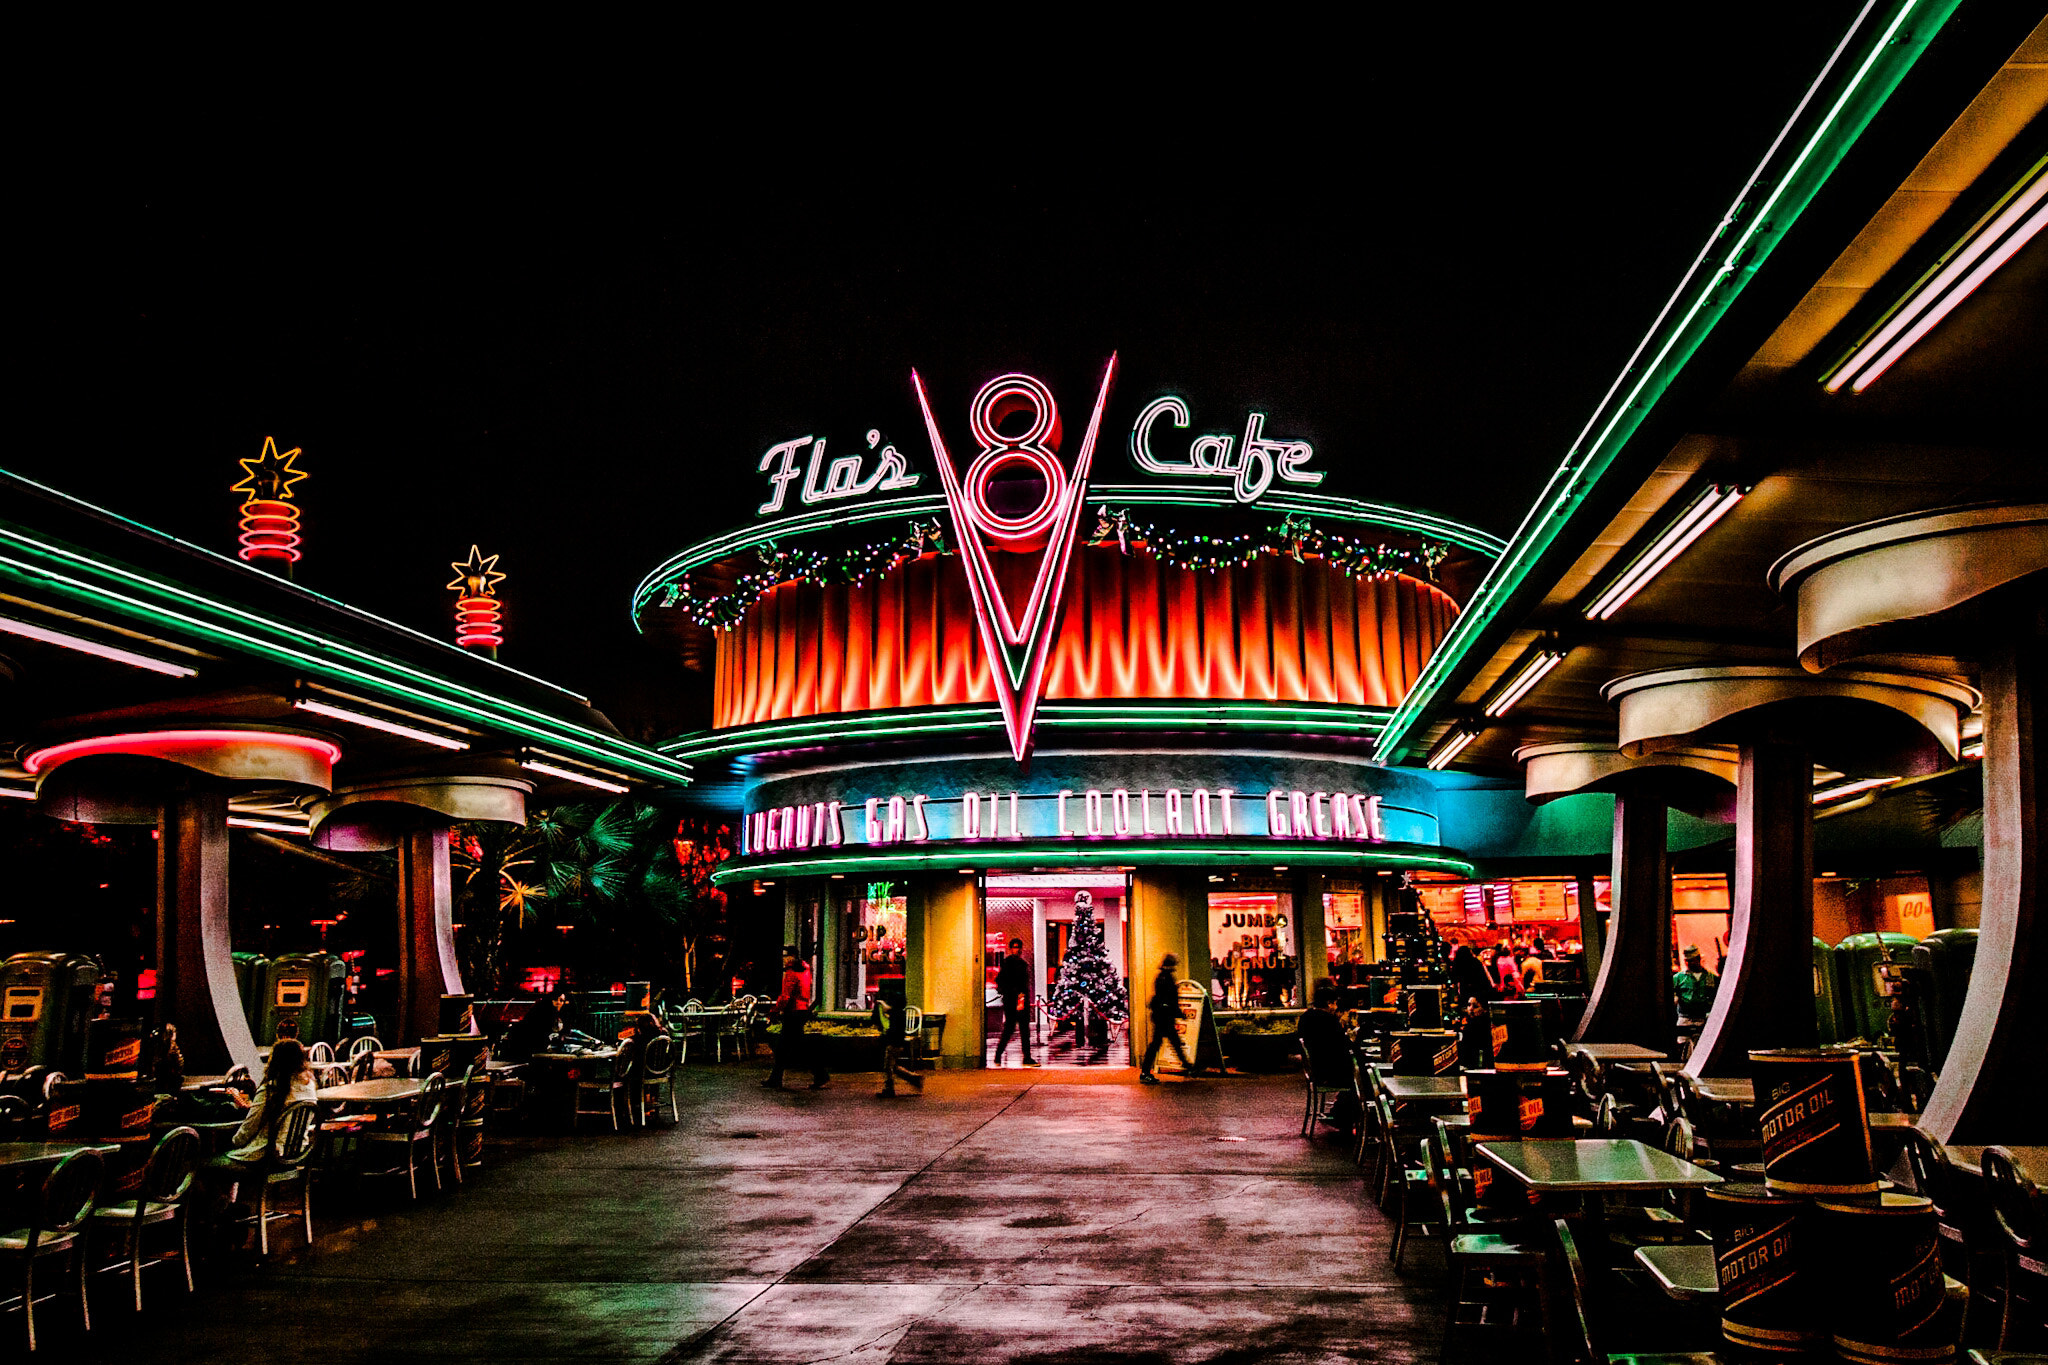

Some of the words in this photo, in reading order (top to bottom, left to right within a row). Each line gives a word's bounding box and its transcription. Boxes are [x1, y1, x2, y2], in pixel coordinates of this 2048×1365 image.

[758, 427, 920, 515] Flo's
[1131, 396, 1324, 503] Cafe
[865, 795, 929, 842] GAS
[962, 791, 1022, 839] OIL
[1058, 789, 1234, 836] COOLANT
[1268, 790, 1386, 840] GREASE
[1222, 913, 1288, 928] JUMBO
[855, 925, 887, 942] DIP
[1241, 934, 1275, 949] BIG
[1211, 955, 1299, 972] LUGNUTS
[1771, 1082, 1790, 1101] BIG
[1761, 1100, 1806, 1143] MOTOR
[1809, 1089, 1834, 1115] OIL
[1734, 1223, 1754, 1242] BIG
[1721, 1245, 1769, 1286] MOTOR
